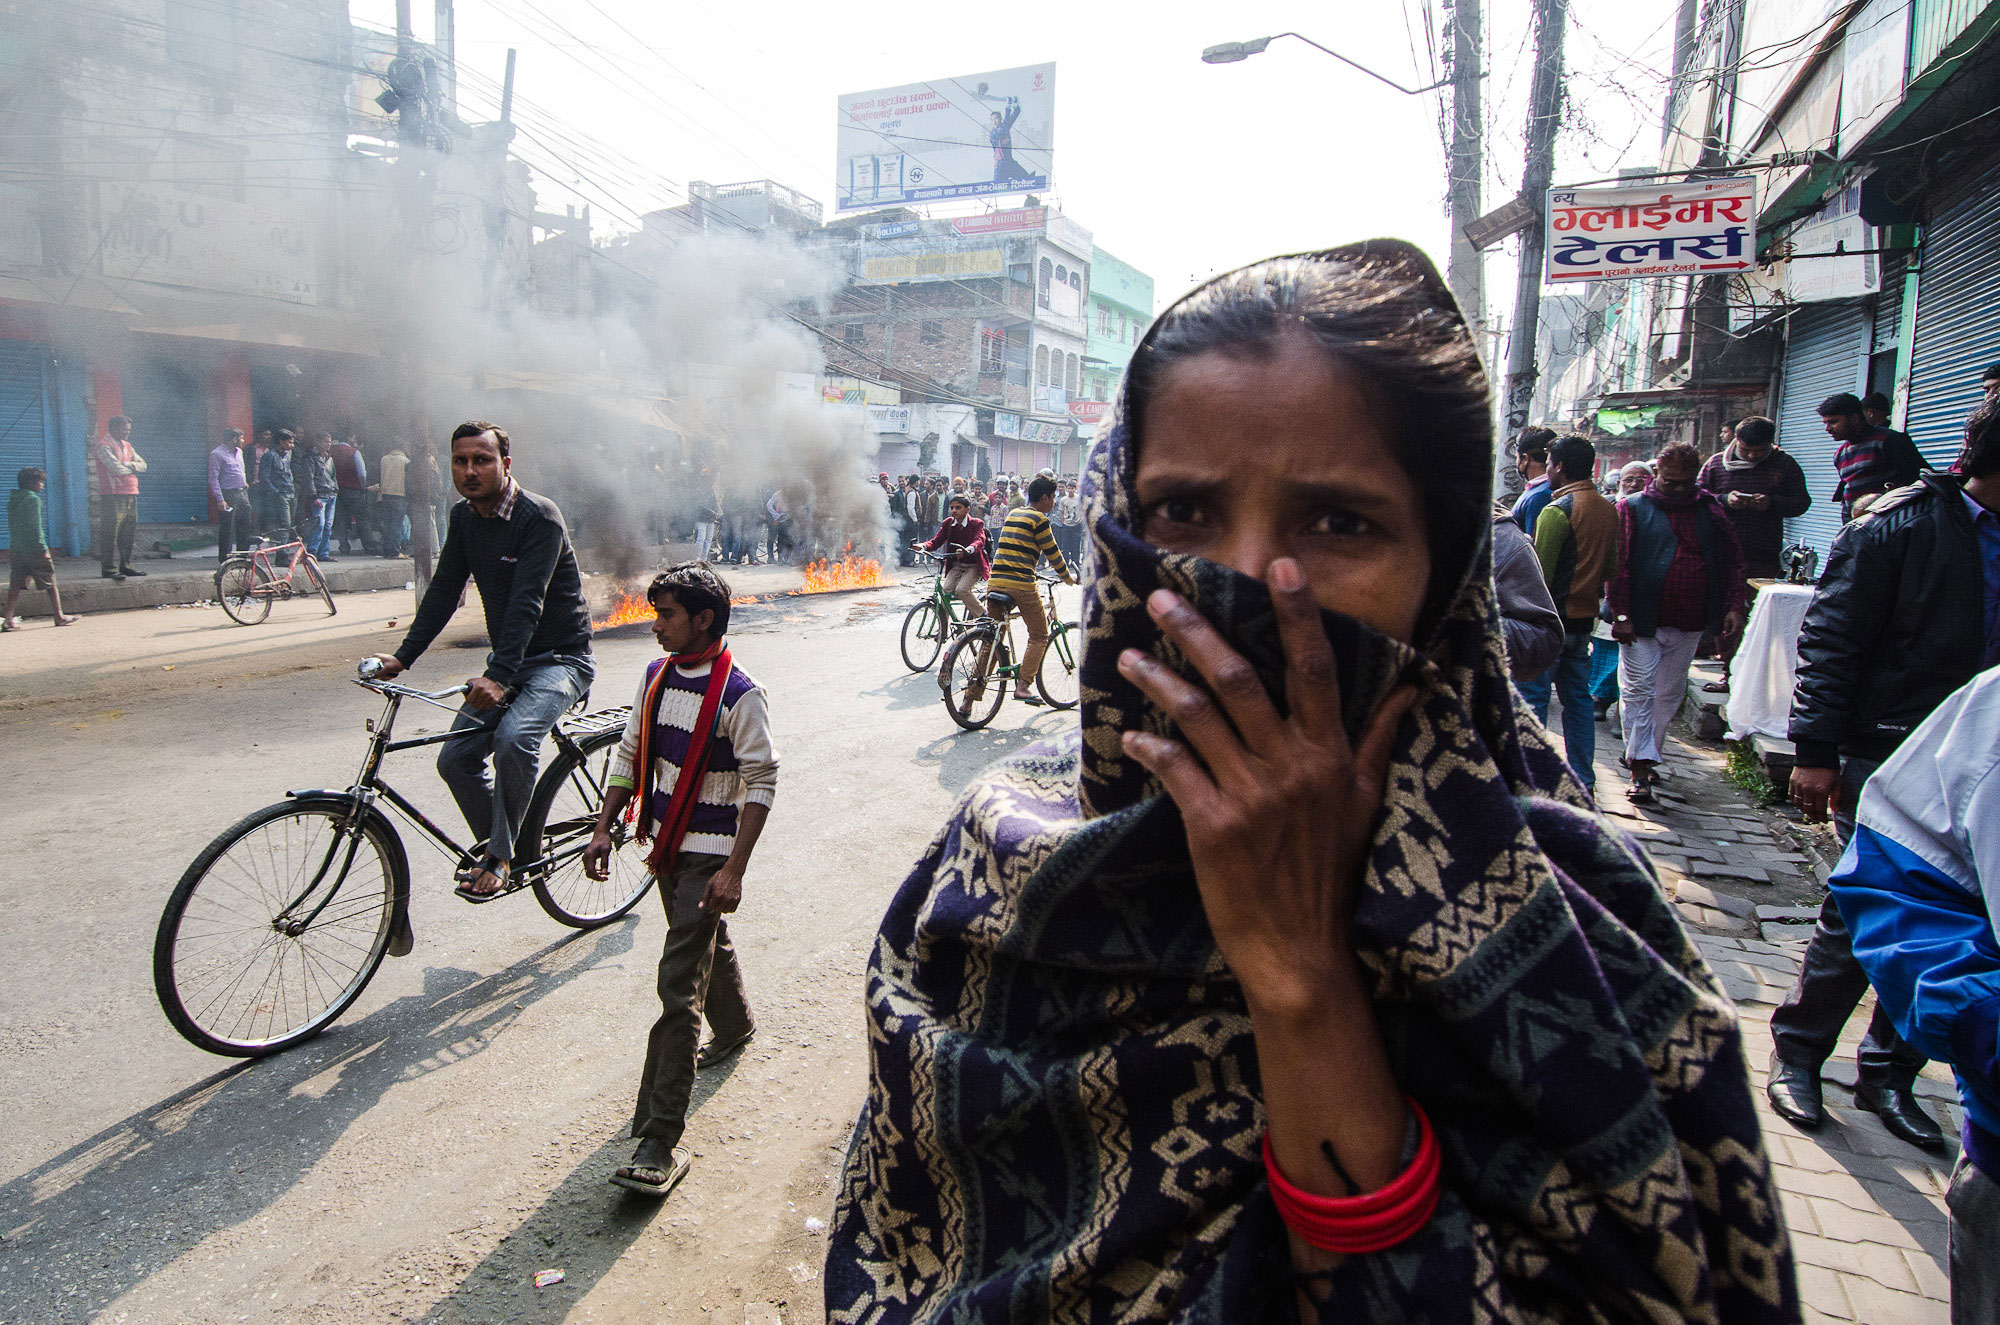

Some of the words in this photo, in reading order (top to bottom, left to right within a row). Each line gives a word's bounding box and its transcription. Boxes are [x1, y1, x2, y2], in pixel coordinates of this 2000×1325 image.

[965, 216, 993, 227] CAMBRIDGE
[994, 213, 1024, 224] INSTITUTE
[1552, 194, 1753, 232] ग्लाईमर
[1553, 226, 1751, 266] टेलर्स
[1604, 267, 1631, 278] पुरानो
[1672, 262, 1697, 273] टेलर्स
